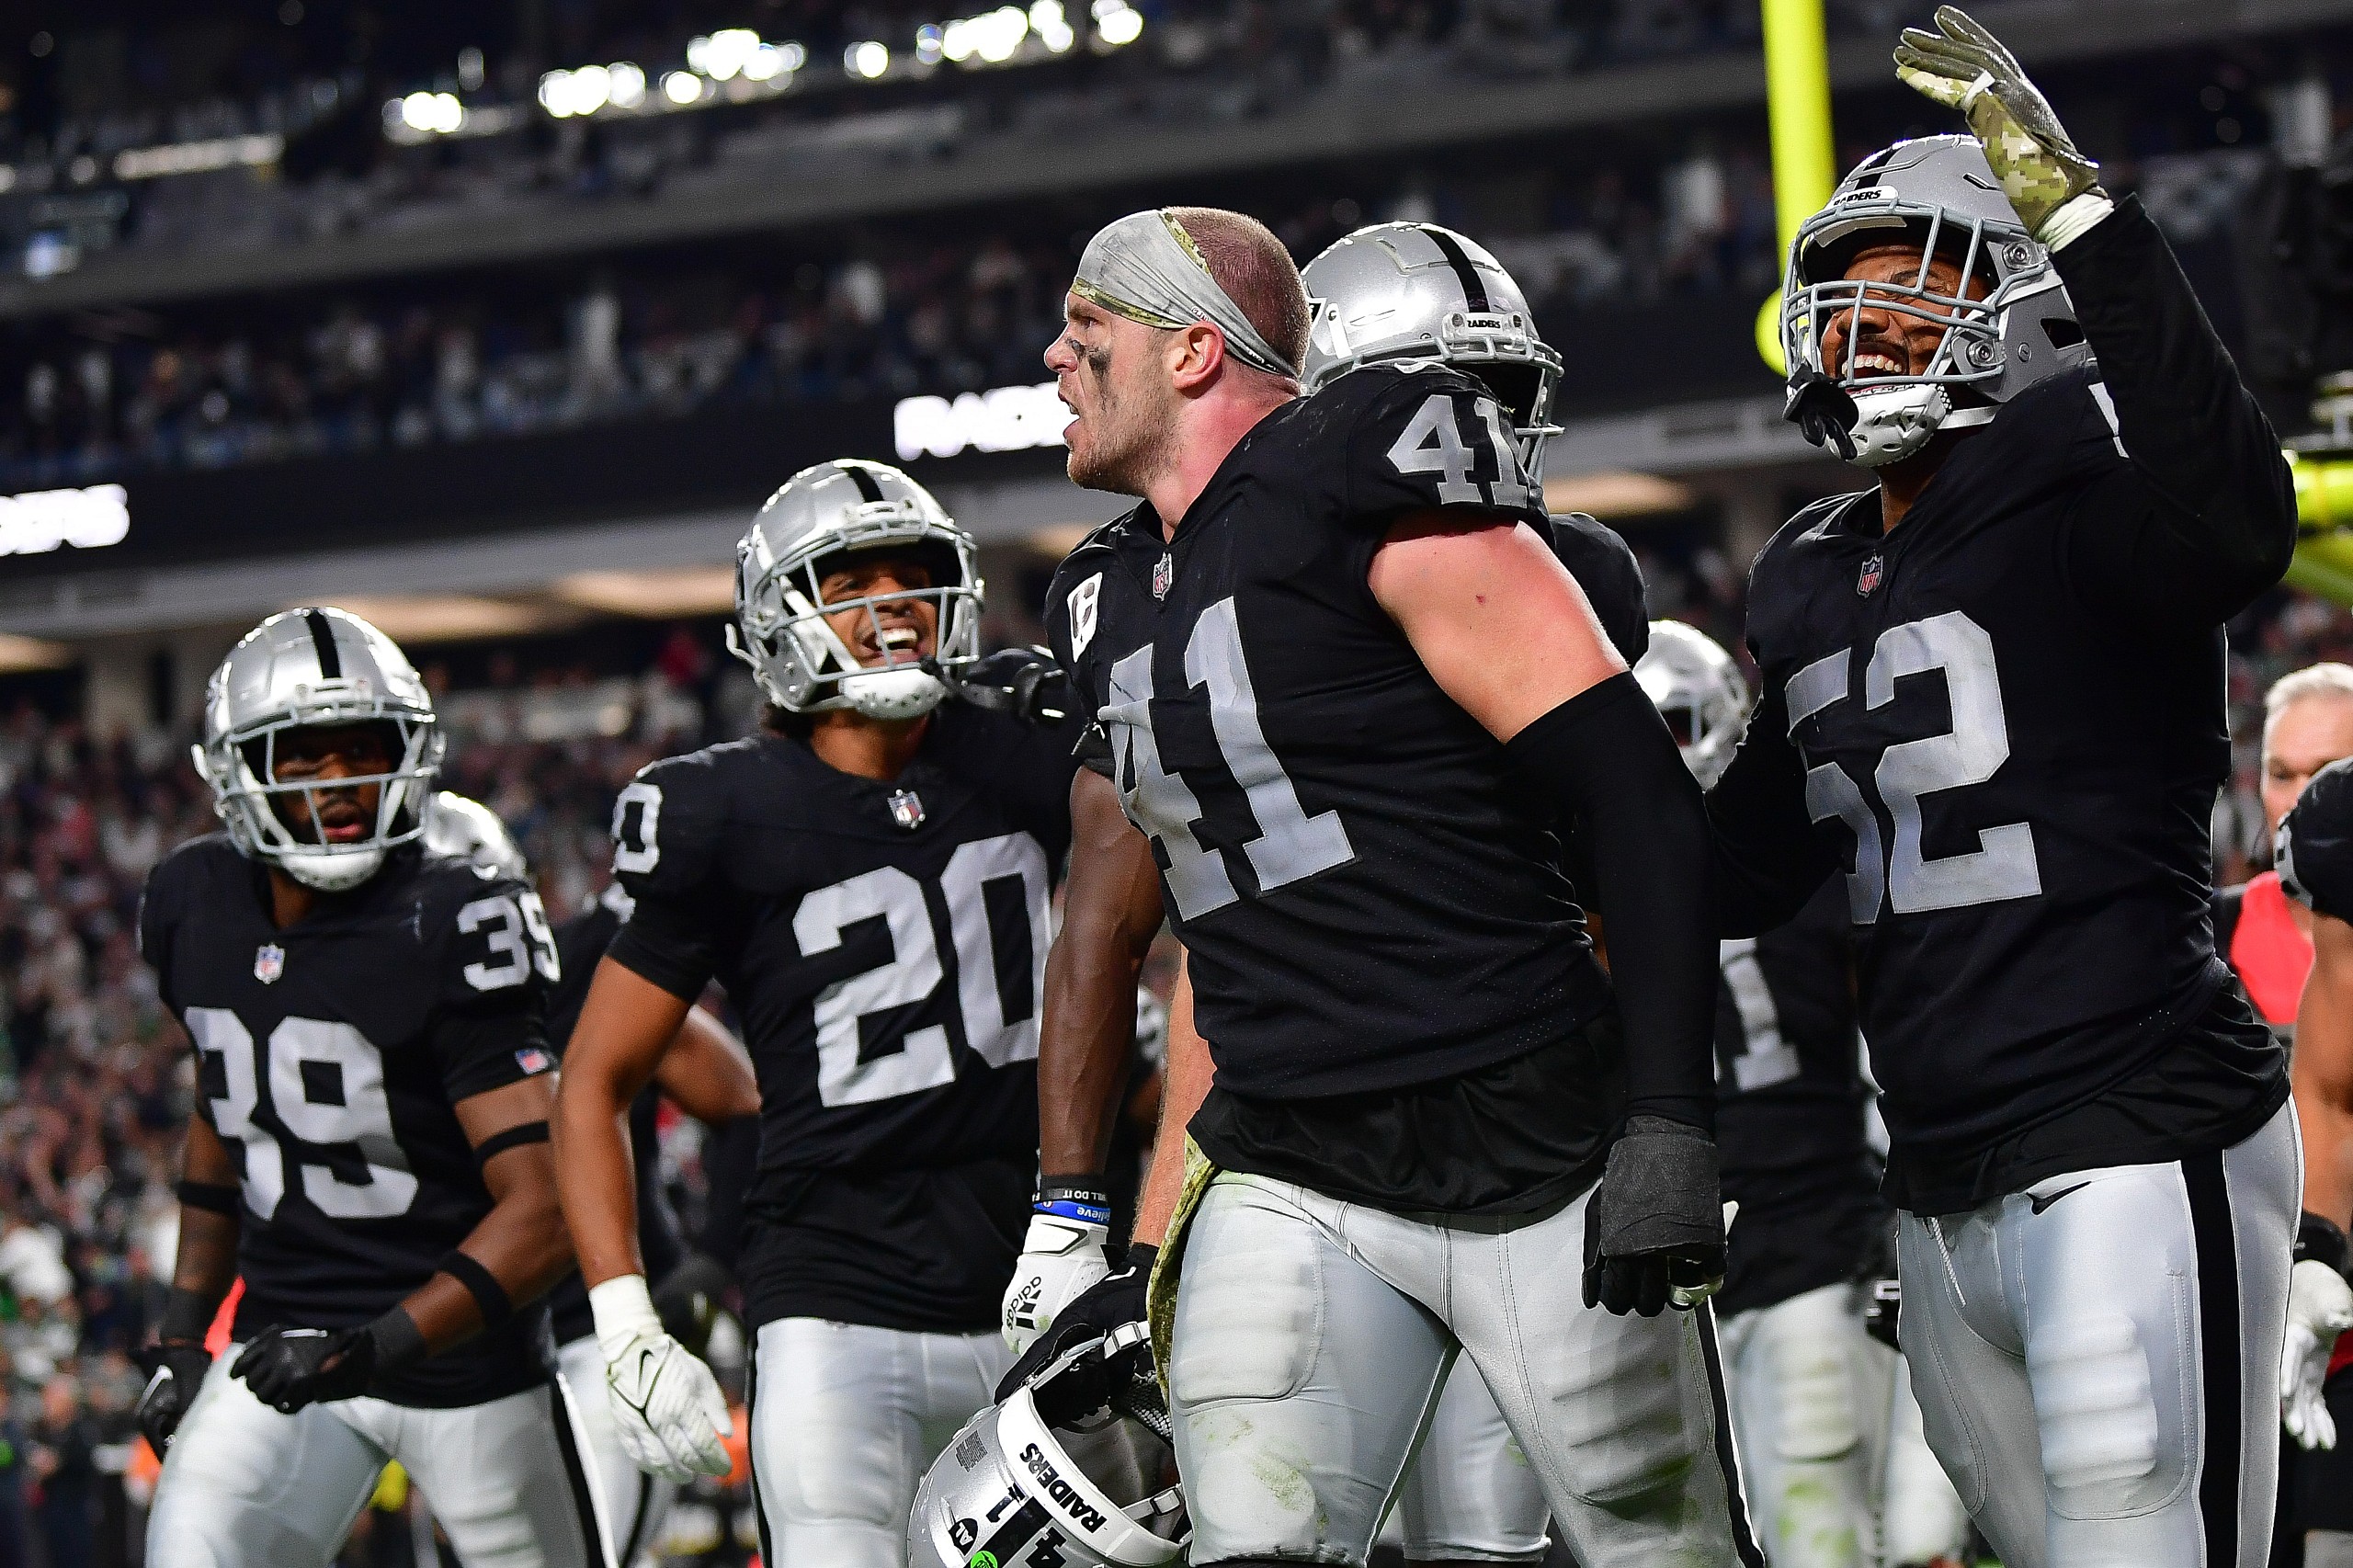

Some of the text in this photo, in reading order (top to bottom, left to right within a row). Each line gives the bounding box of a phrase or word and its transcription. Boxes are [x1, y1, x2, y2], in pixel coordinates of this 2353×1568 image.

[1386, 394, 1528, 509] 41
[1097, 595, 1356, 922] 41
[1785, 609, 2042, 926] 52
[457, 892, 561, 992] 39
[791, 829, 1053, 1108] 20
[184, 1006, 419, 1221] 39
[1062, 1188, 1074, 1199] IT
[1074, 1189, 1090, 1199] DO
[1006, 1276, 1041, 1331] adidas
[1019, 1442, 1108, 1534] RAIDERS
